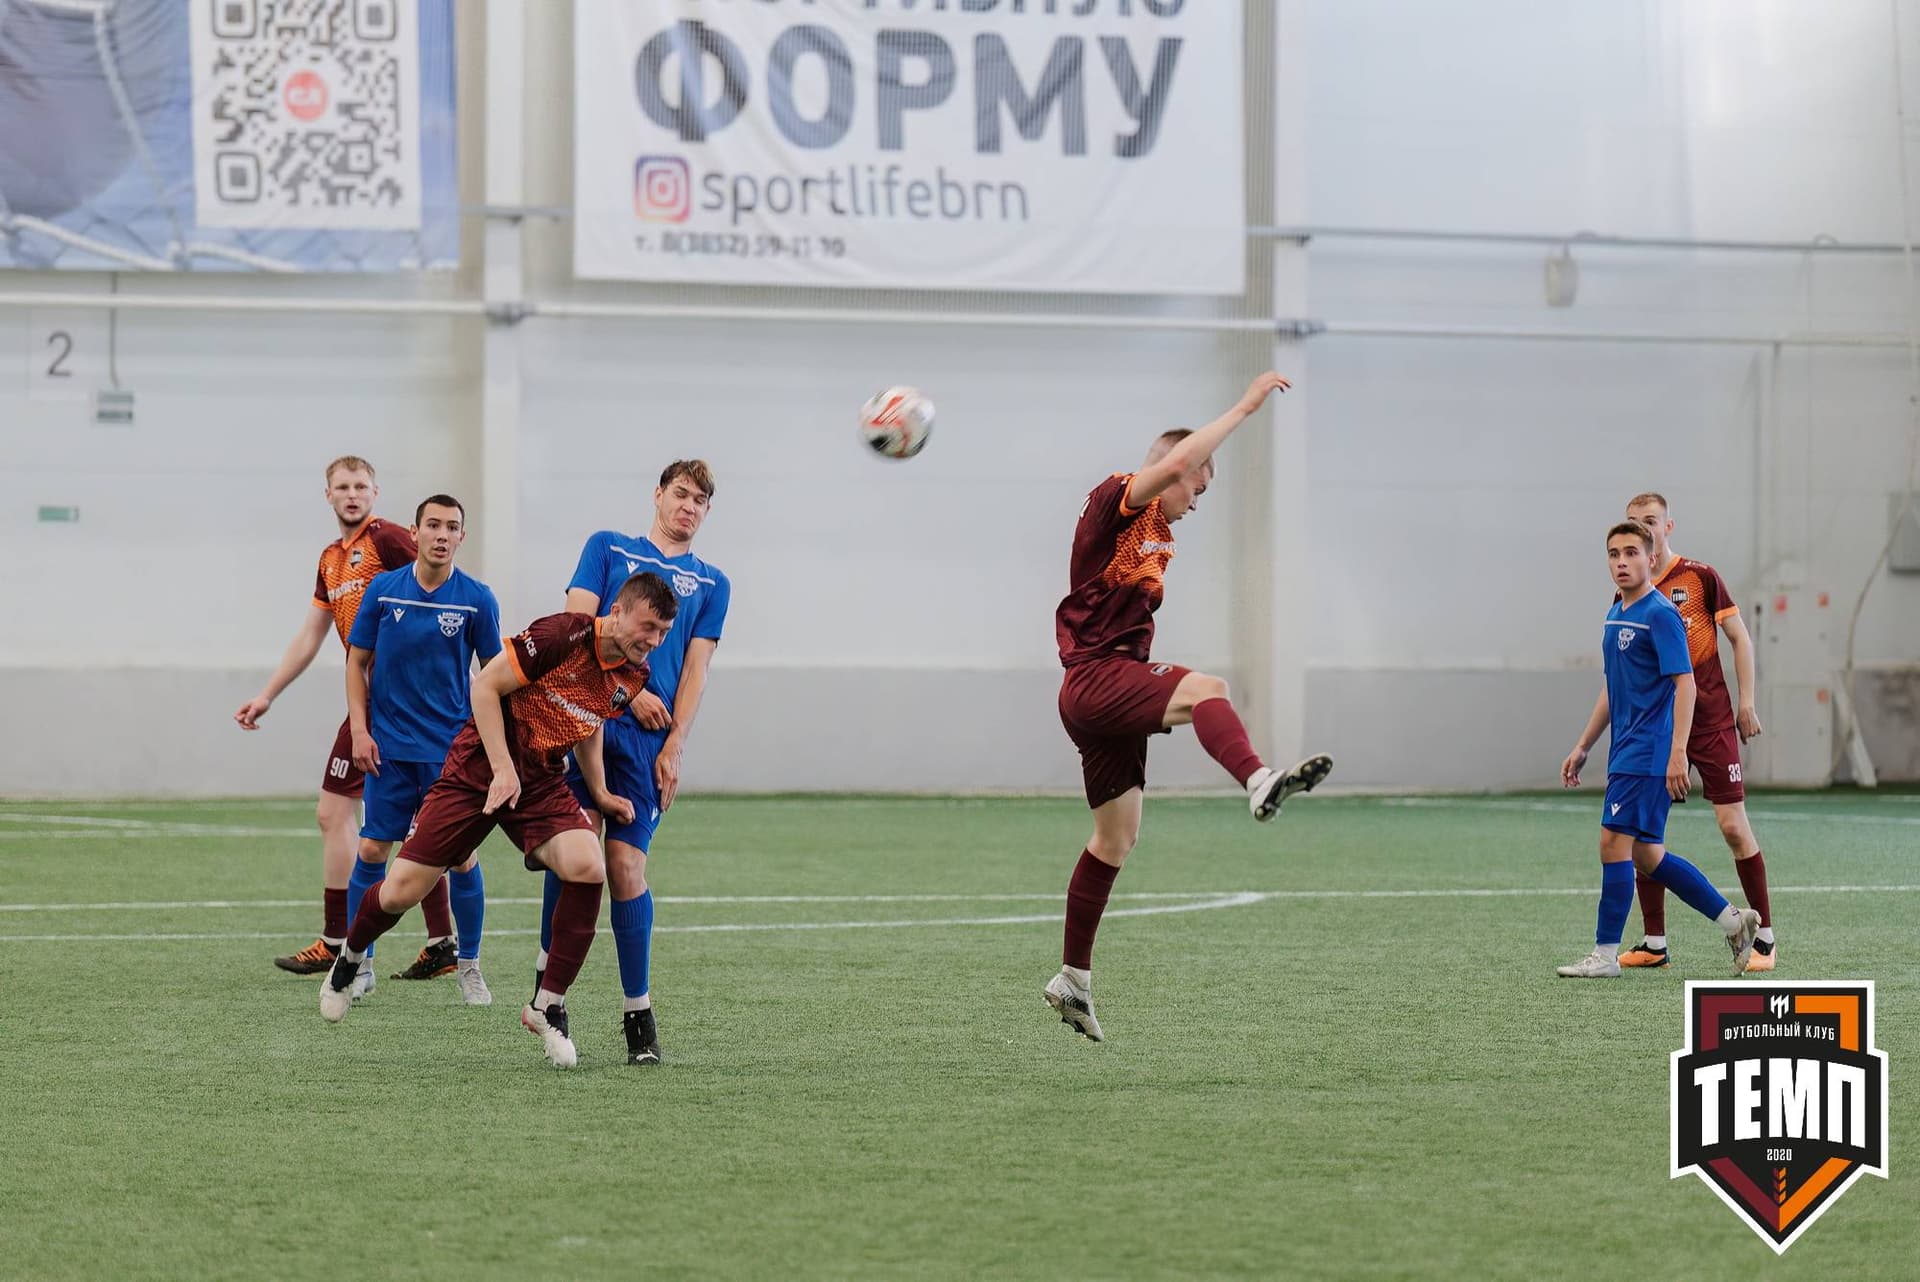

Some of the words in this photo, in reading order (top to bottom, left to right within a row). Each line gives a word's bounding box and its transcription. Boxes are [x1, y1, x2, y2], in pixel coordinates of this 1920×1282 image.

[634, 19, 1184, 158] ФОРМУ
[700, 165, 1029, 225] sportlifebrn
[48, 330, 73, 377] 2
[330, 756, 350, 779] 90
[1728, 763, 1742, 782] 33
